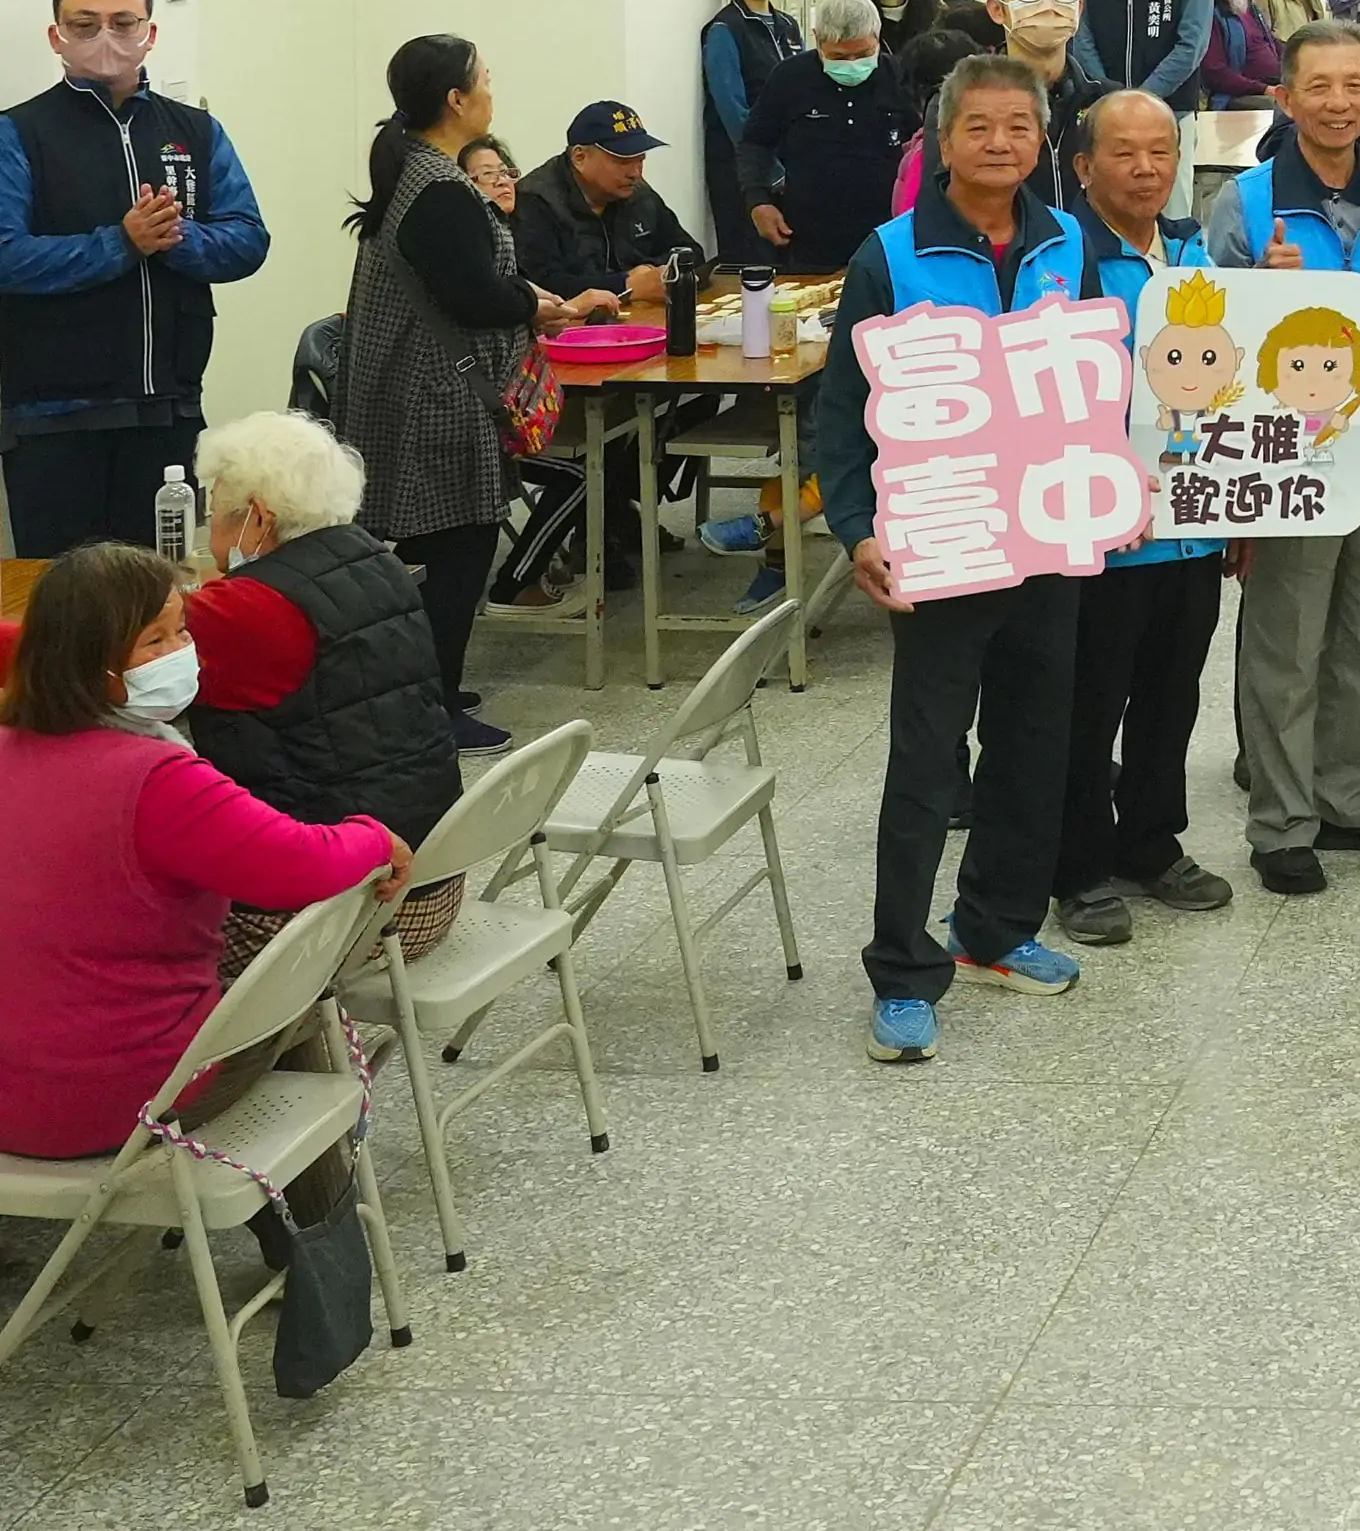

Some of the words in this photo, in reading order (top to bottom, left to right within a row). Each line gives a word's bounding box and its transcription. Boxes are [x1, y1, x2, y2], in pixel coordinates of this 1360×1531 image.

[862, 302, 1122, 441] 富市
[1200, 412, 1300, 464] 大雅
[882, 444, 1142, 593] 臺中
[1170, 471, 1325, 525] 歡迎你
